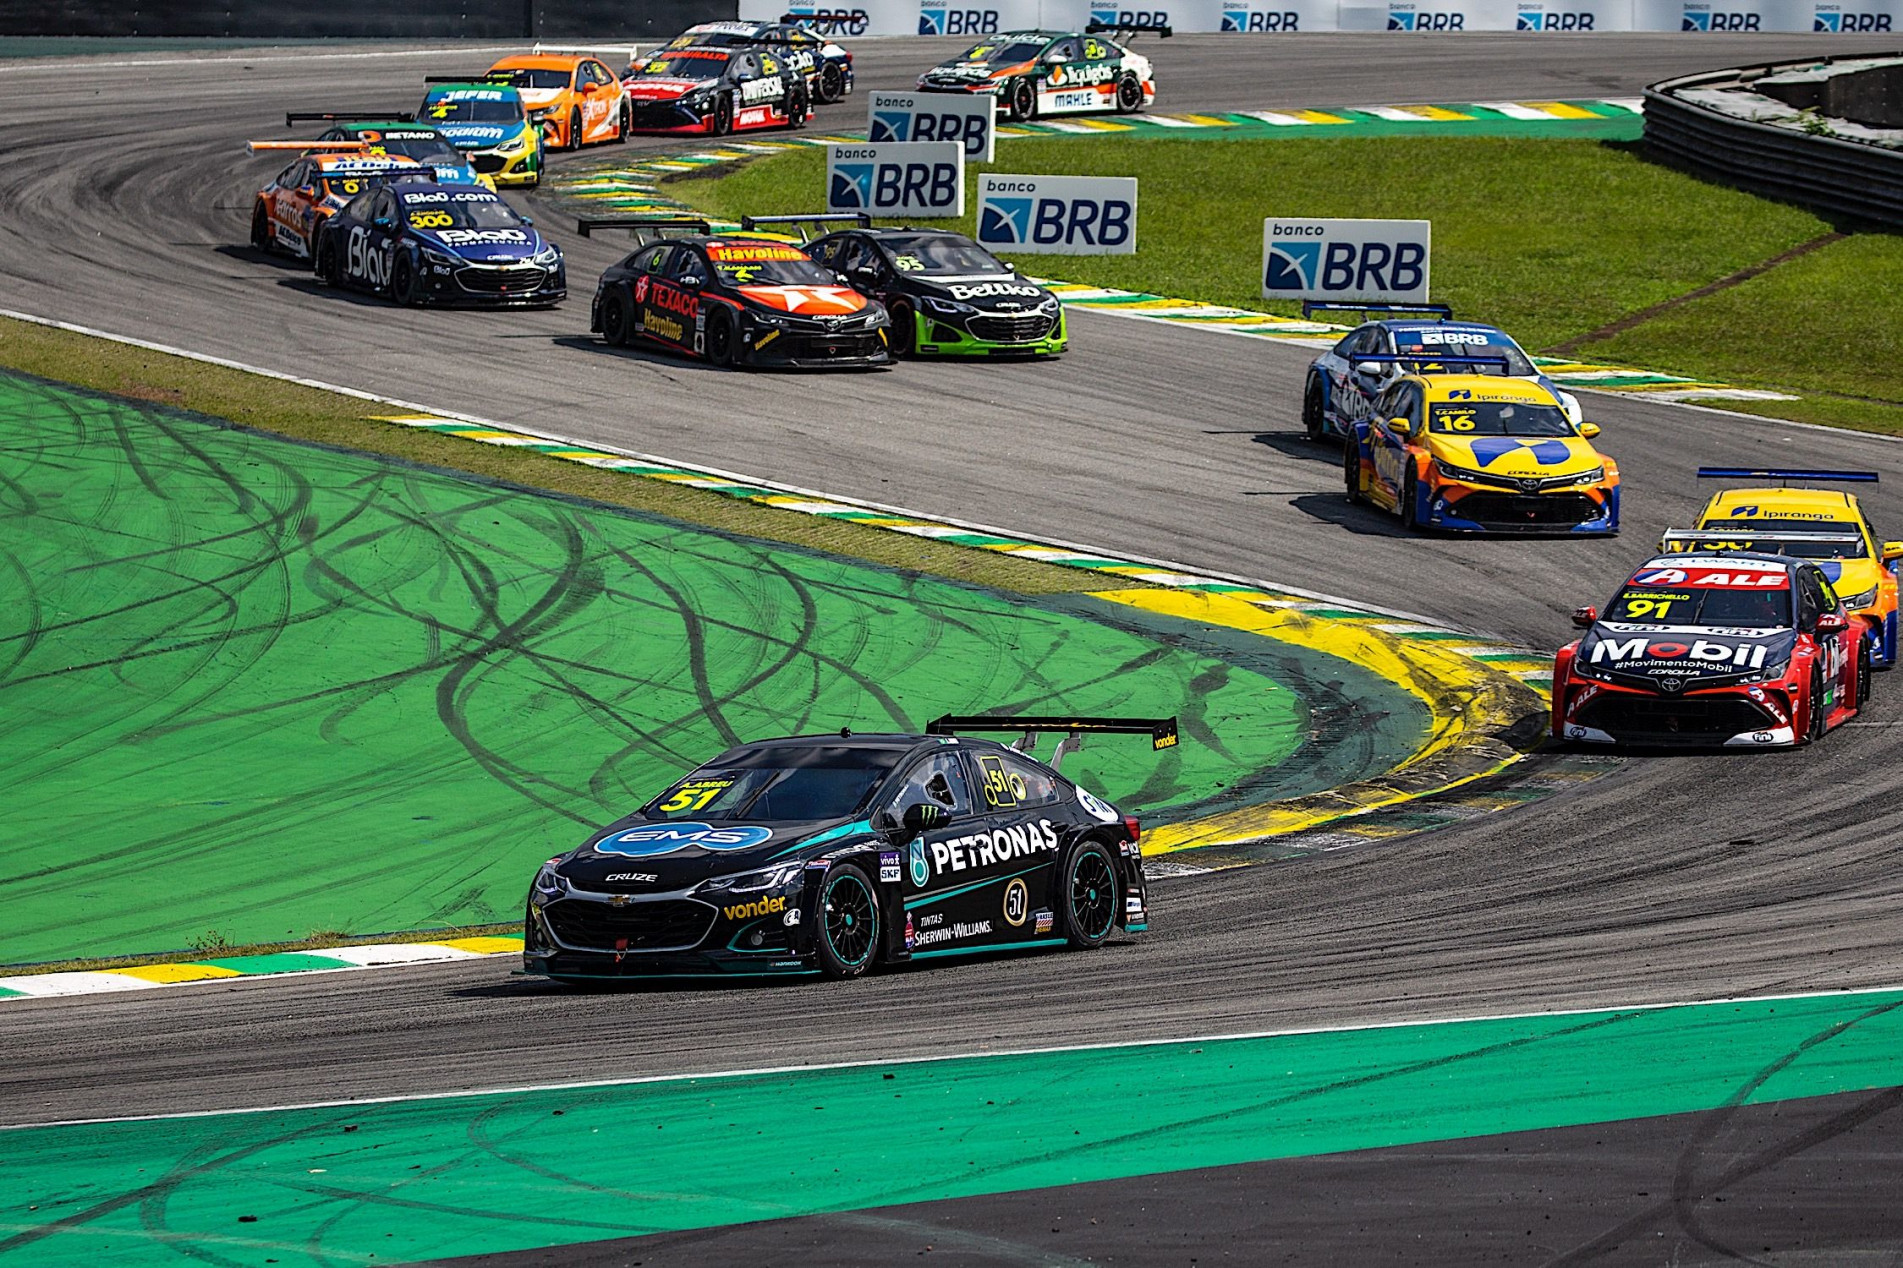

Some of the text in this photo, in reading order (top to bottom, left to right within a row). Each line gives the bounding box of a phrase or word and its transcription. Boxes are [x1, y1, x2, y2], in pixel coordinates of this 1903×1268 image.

[947, 10, 999, 35] BRB
[1250, 12, 1298, 31] BRB
[1416, 13, 1464, 31] BRB
[1545, 13, 1594, 31] BRB
[1710, 13, 1760, 31] BRB
[1841, 13, 1892, 31] BRB
[440, 90, 503, 102] JEFER
[875, 96, 914, 108] banco
[1055, 93, 1092, 107] MAHLE
[385, 131, 435, 141] BETANO
[835, 147, 877, 160] banco
[875, 163, 957, 207] BRB
[986, 179, 1036, 193] banco
[409, 214, 454, 230] 300
[1032, 198, 1131, 246] BRB
[1272, 223, 1325, 236] banco
[652, 253, 661, 266] 6
[718, 247, 803, 261] Havoline
[895, 258, 926, 272] 95
[1321, 242, 1425, 291] BRB
[947, 281, 1041, 300] Bellko
[651, 282, 700, 320] TEXACO
[643, 308, 684, 342] Havoline
[754, 328, 781, 351] Havoline
[1443, 332, 1489, 346] BRB
[1438, 415, 1476, 432] 16
[1763, 509, 1834, 521] Ipiranga
[1693, 573, 1788, 587] ALE
[1625, 599, 1672, 619] 91
[1589, 636, 1768, 668] Mobil
[1614, 659, 1733, 673] #MovimentoMobil
[1647, 668, 1701, 676] COROLLA
[1154, 732, 1177, 750] vonder
[989, 769, 1009, 794] 51
[659, 788, 723, 812] 51
[618, 829, 750, 844] EMS
[930, 818, 1059, 875] PETRONAS
[604, 873, 659, 883] CRUZE
[881, 868, 900, 879] SKF
[1008, 885, 1022, 916] 51
[920, 912, 944, 927] TINTAS
